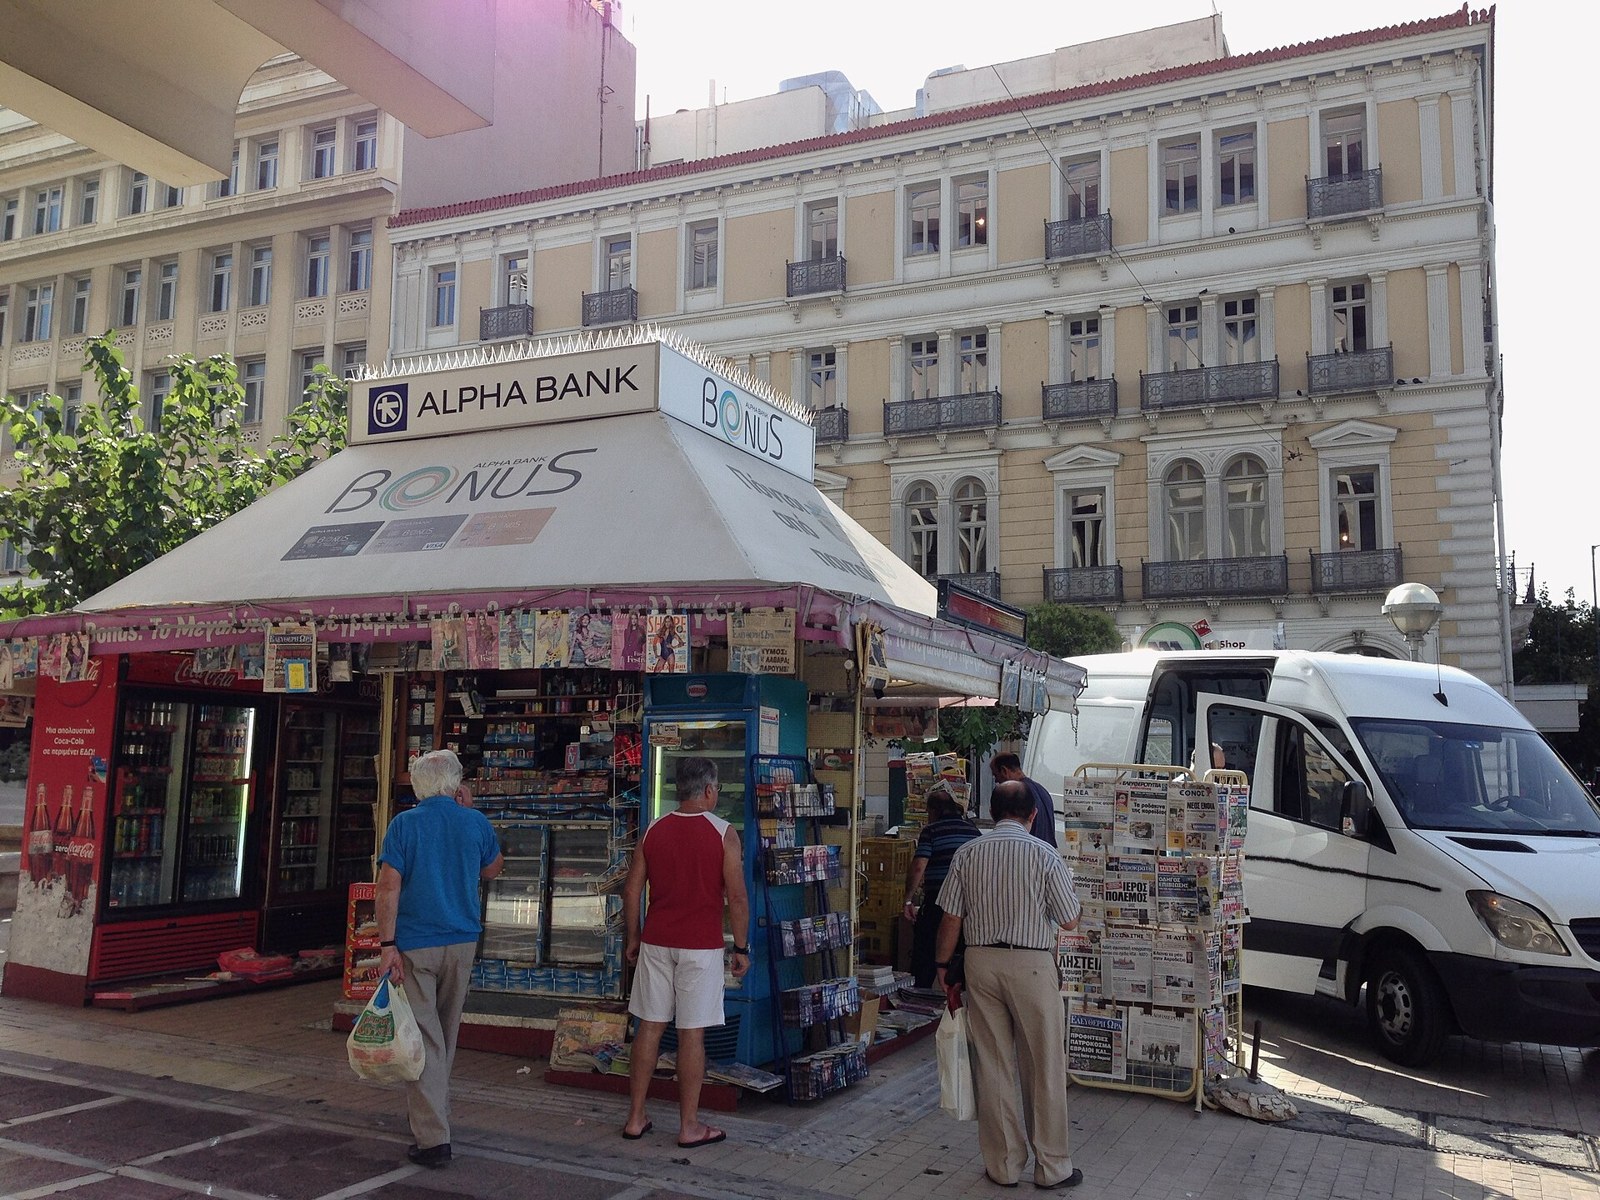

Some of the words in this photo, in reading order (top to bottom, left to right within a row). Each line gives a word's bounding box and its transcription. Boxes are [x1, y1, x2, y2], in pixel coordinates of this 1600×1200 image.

[417, 379, 528, 418] ALPHA
[535, 364, 640, 403] BANK
[702, 377, 783, 460] BONUS
[474, 459, 512, 469] ALPHA
[513, 456, 548, 465] BANK
[325, 448, 598, 514] BONUS
[425, 543, 444, 551] VISA
[647, 615, 687, 633] SHPE
[1220, 640, 1246, 649] Shop
[57, 727, 95, 735] απολαυστική
[54, 737, 84, 745] Coca-Cola
[51, 748, 79, 756] περιμένει
[55, 845, 69, 853] zero
[1123, 882, 1148, 893] ΙΕΡΟΣ
[353, 888, 373, 900] BIG
[1105, 891, 1148, 903] ΠΟΛΕΜΟΣ
